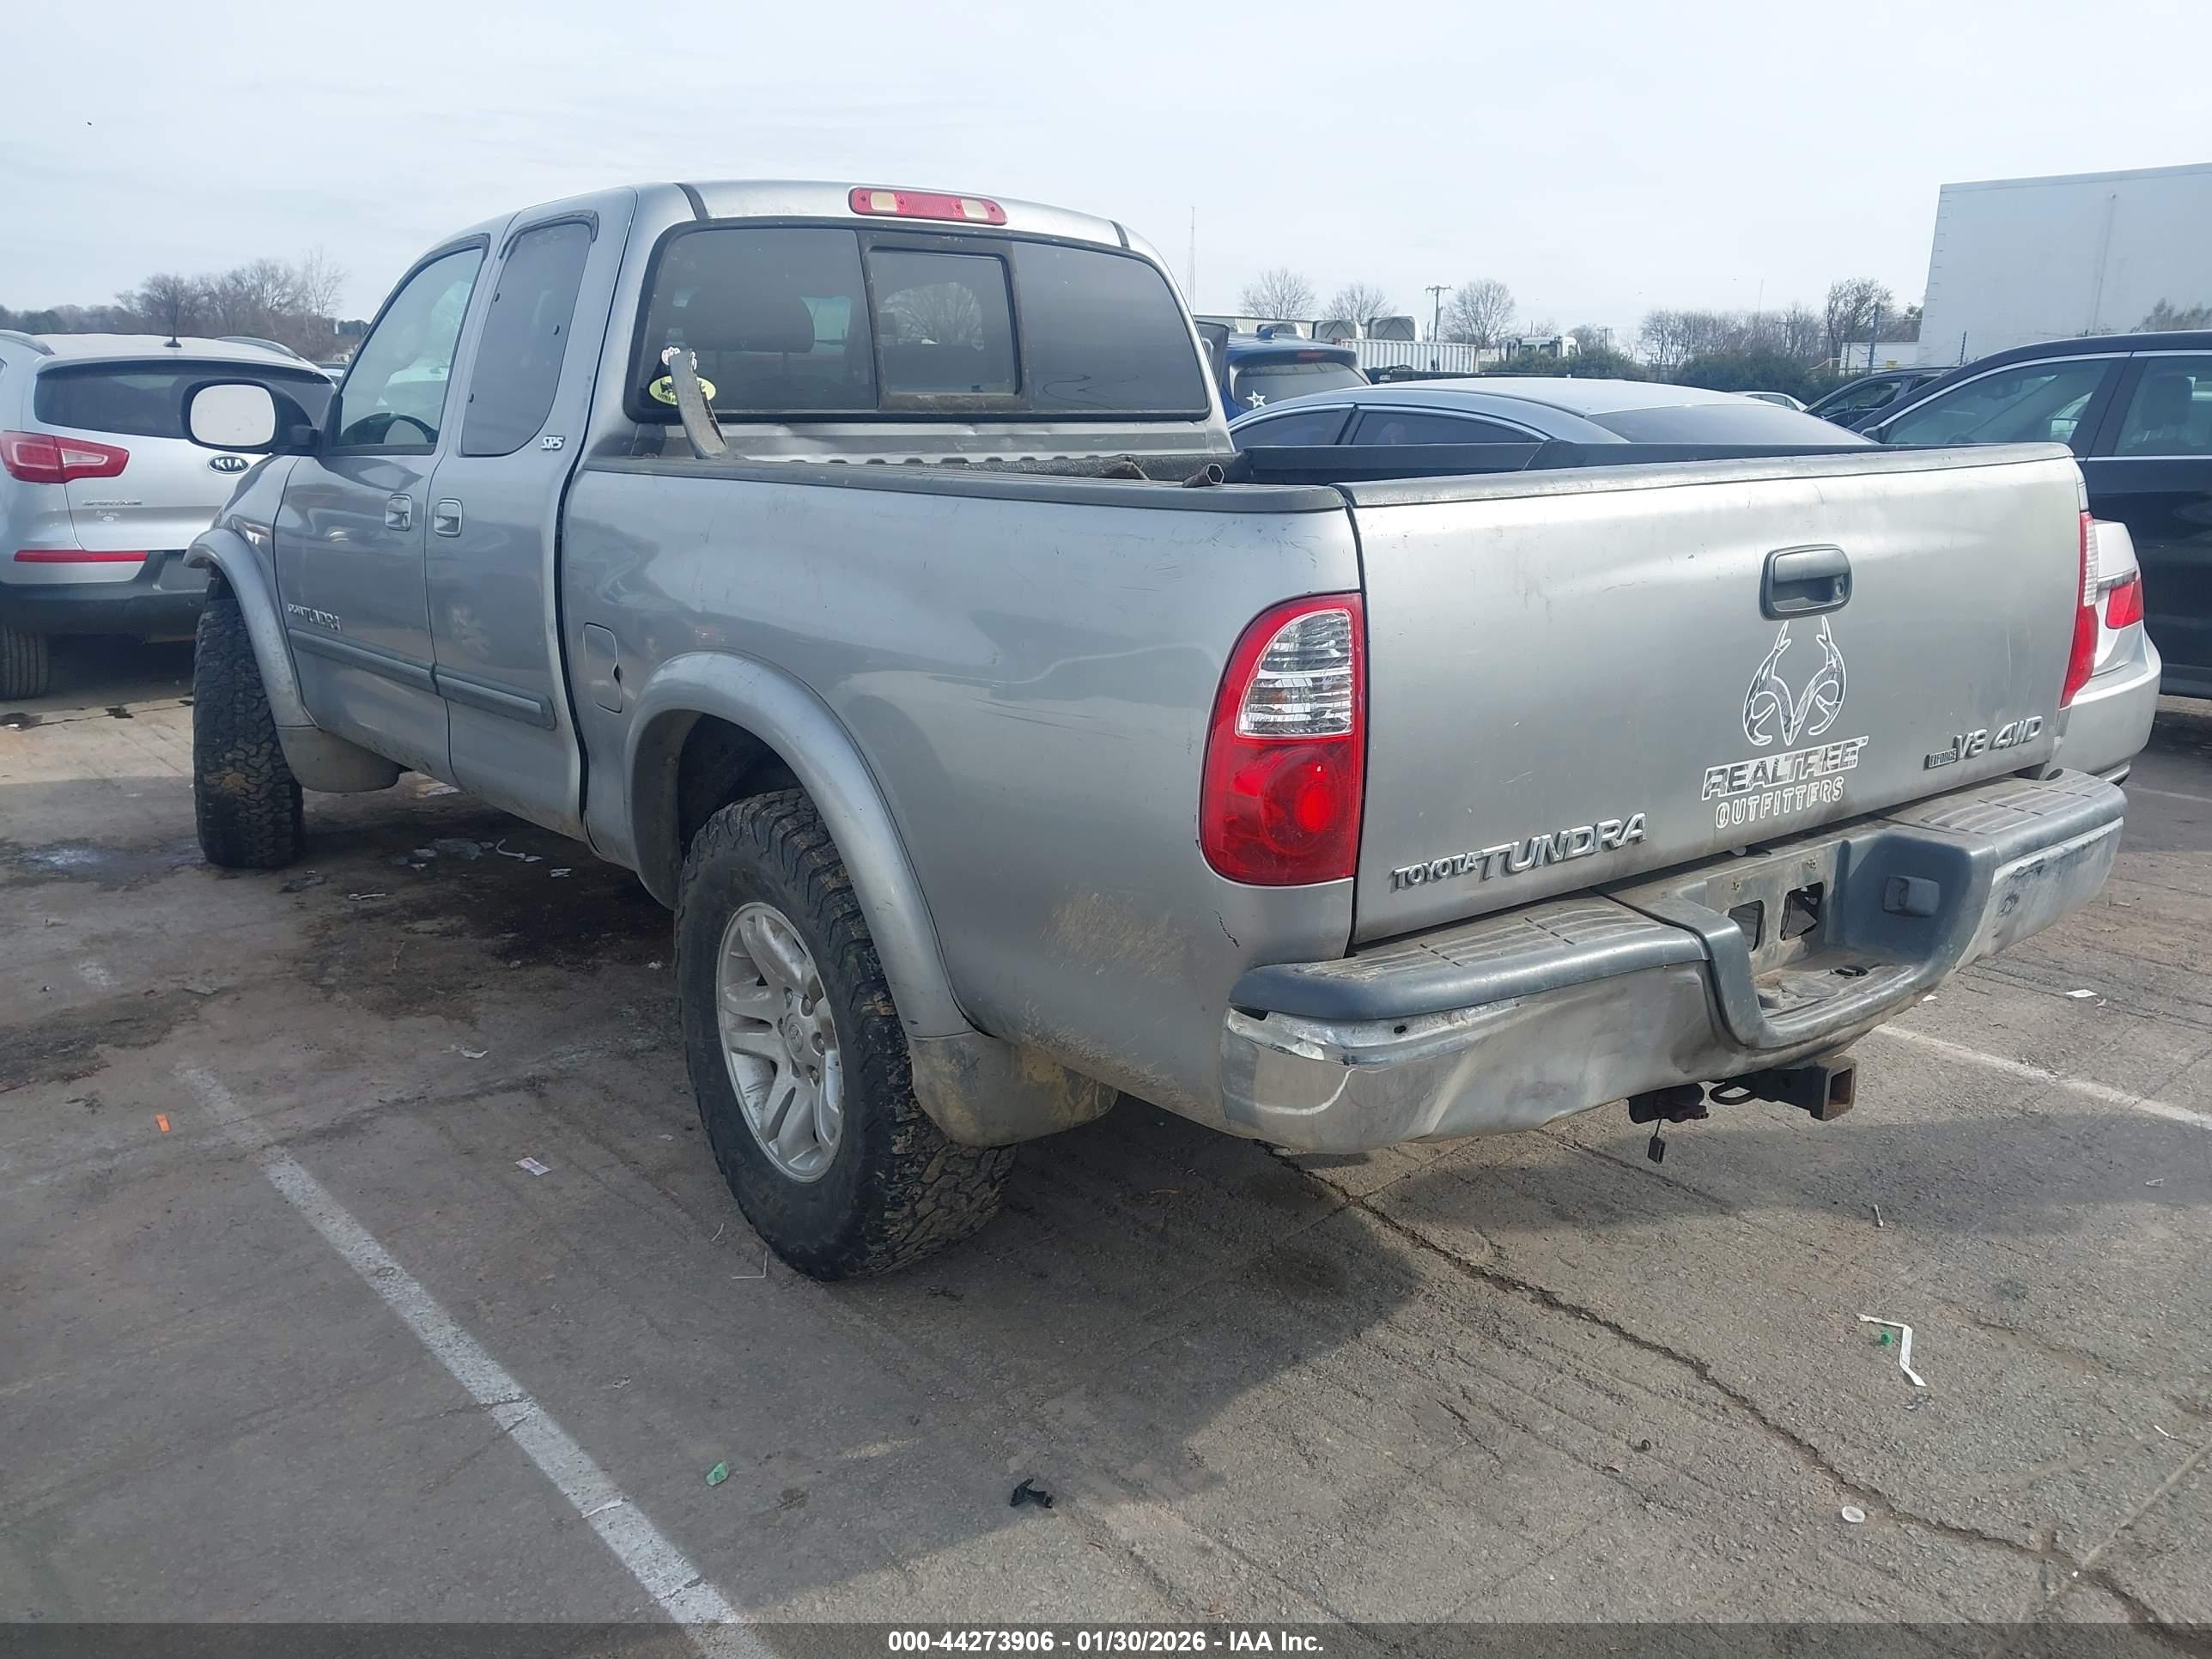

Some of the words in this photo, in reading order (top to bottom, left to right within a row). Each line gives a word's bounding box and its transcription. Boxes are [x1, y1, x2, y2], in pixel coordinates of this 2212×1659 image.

[215, 459, 244, 469] KIA
[541, 436, 564, 449] SR5
[1954, 728, 1987, 759] V8
[1990, 715, 2043, 750] 4WD
[1716, 775, 1844, 829] OUTFITTERS
[1392, 851, 1479, 891] TOYOTA
[1476, 811, 1647, 881] TUNDRA
